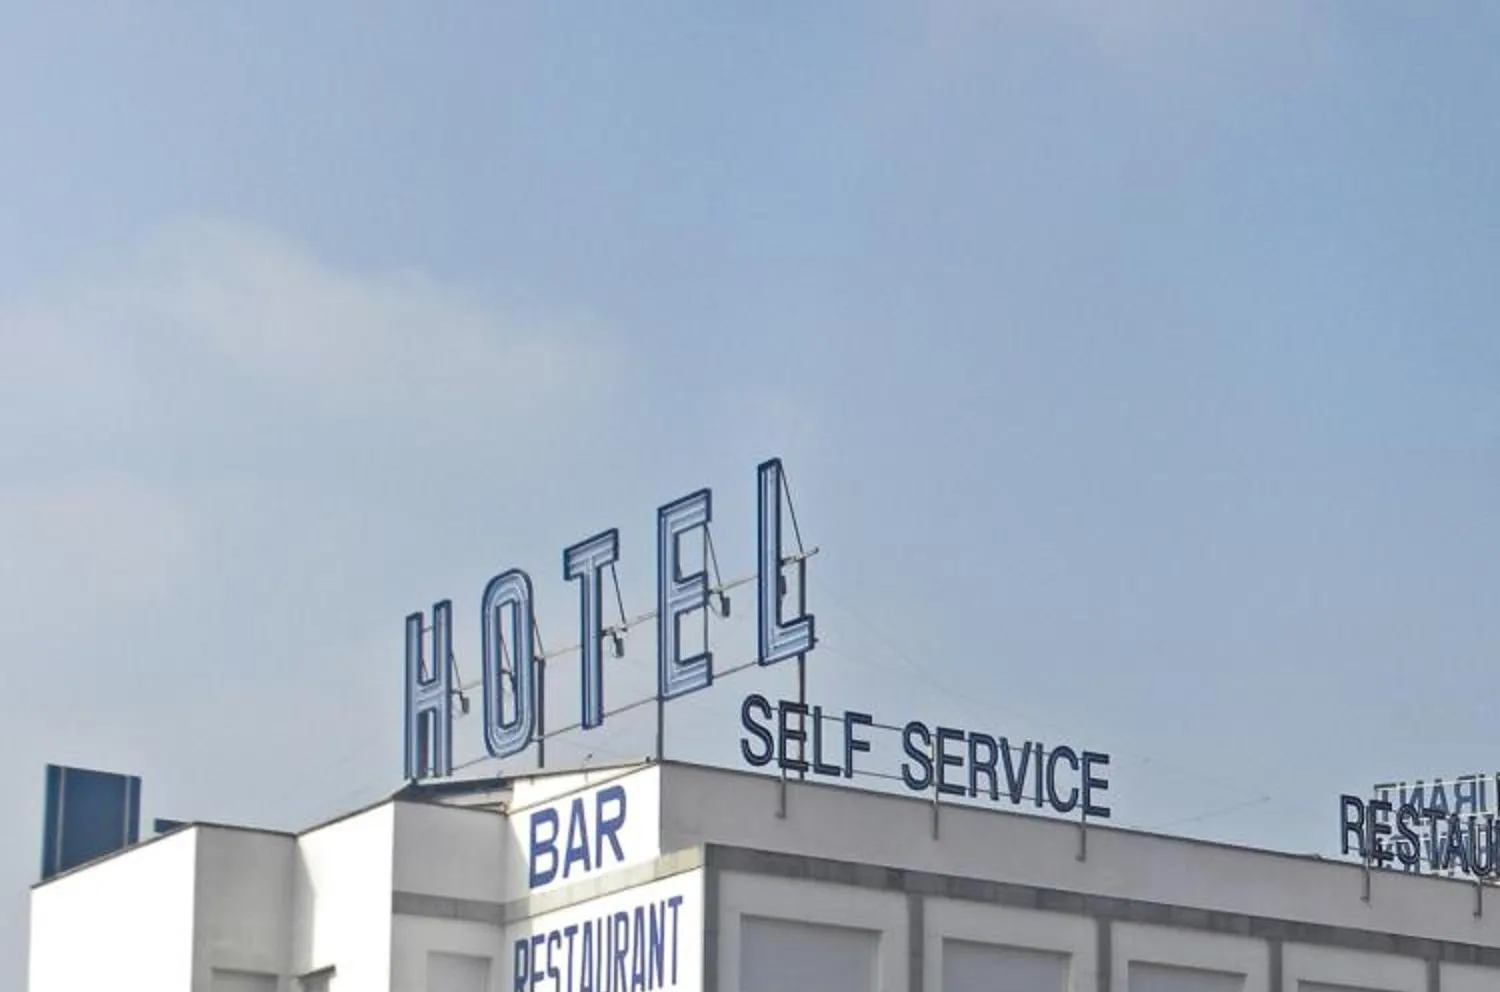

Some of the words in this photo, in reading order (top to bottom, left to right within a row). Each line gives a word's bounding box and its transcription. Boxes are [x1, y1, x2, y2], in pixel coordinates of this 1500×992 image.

[404, 457, 815, 780] HOTEL
[740, 693, 872, 779] SELF
[901, 721, 1111, 818] SERVICE
[529, 785, 627, 889] BAR
